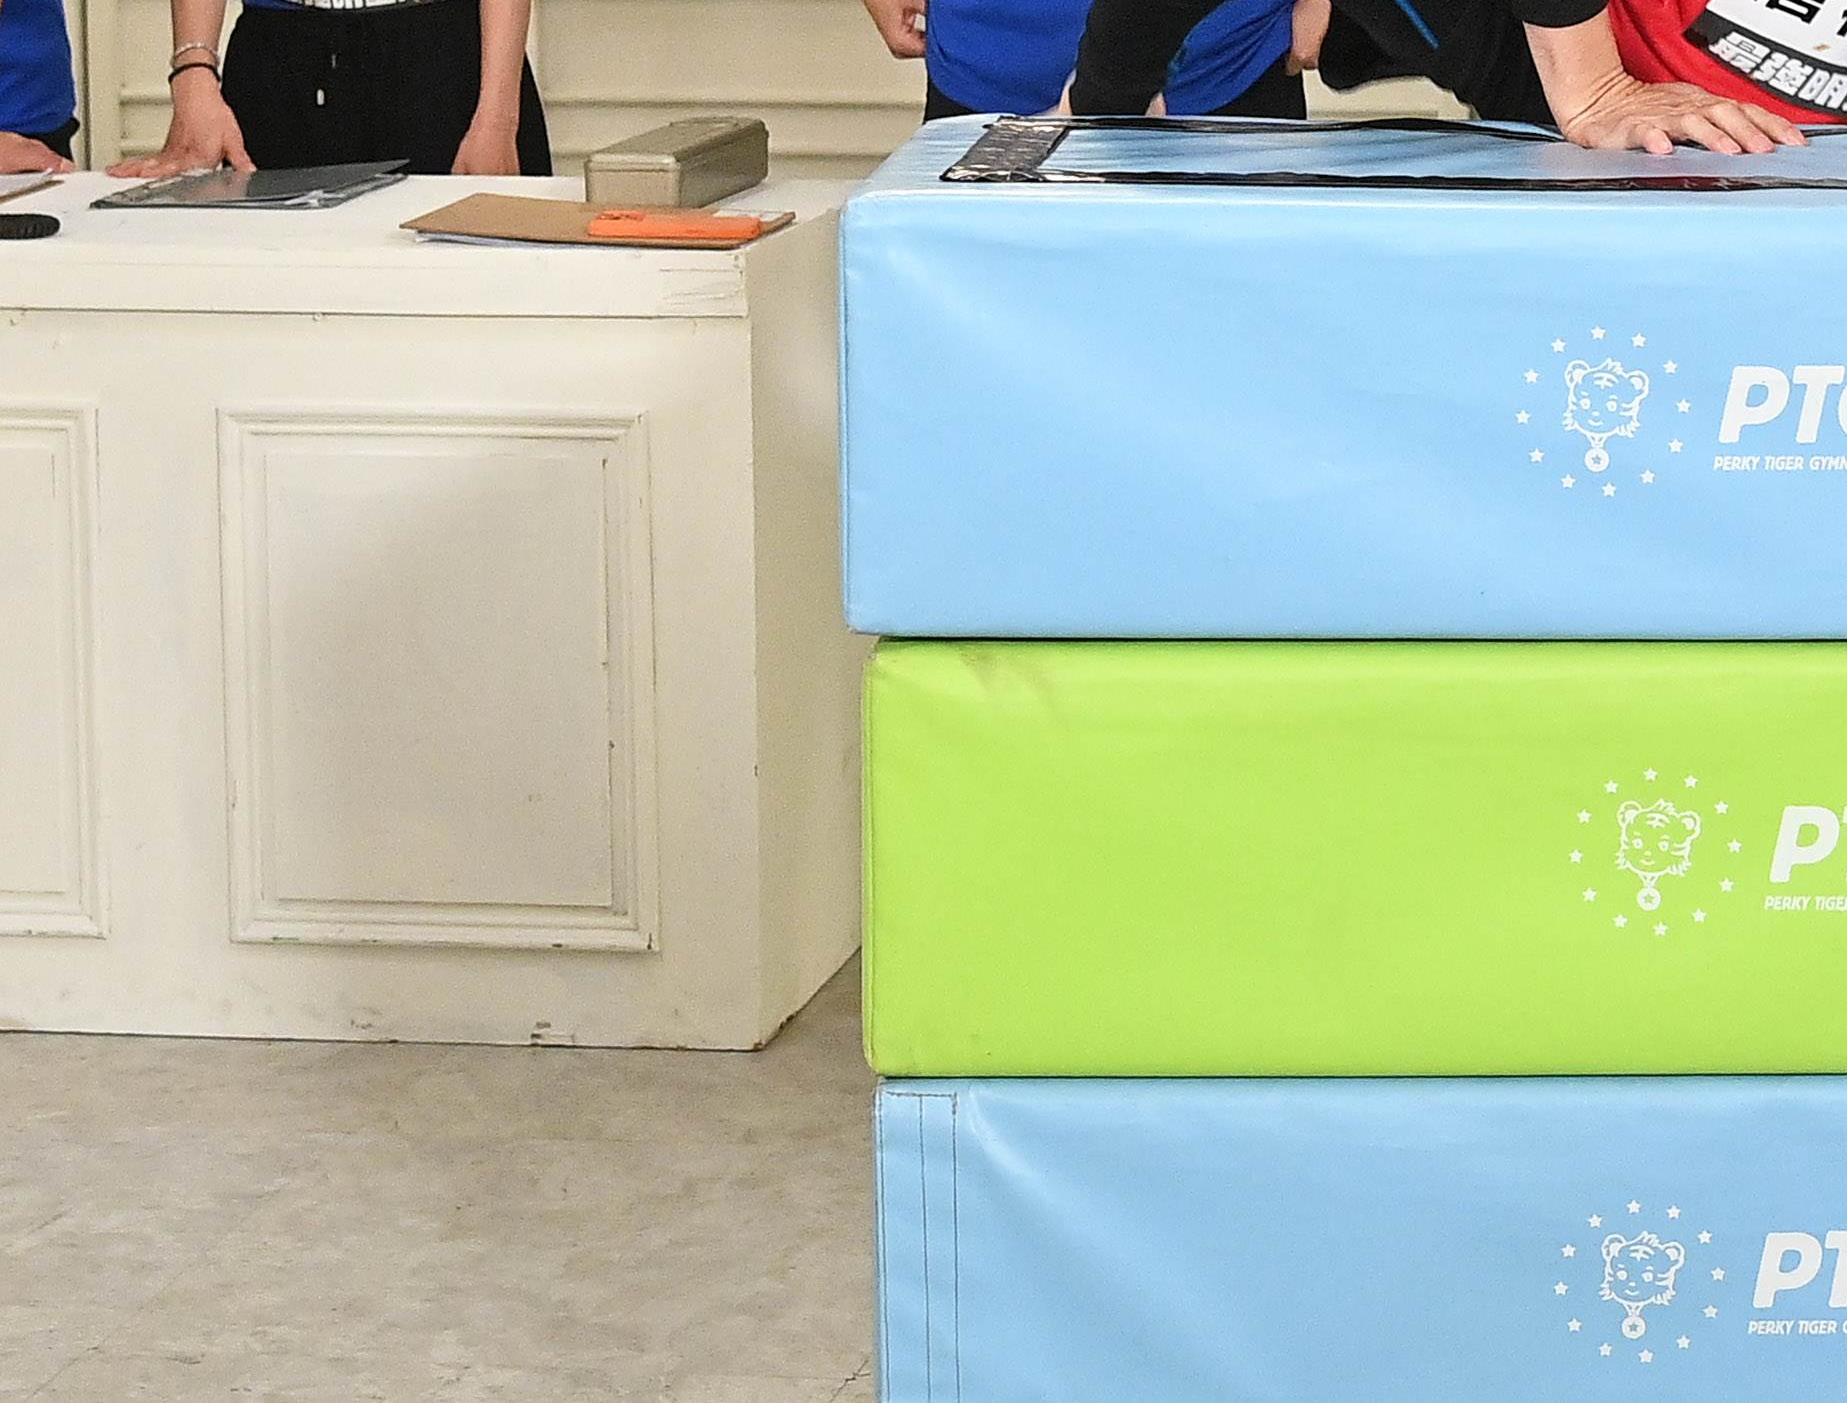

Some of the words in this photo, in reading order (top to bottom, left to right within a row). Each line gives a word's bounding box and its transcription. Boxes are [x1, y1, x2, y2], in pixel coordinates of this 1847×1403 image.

[1713, 456, 1760, 472] PERKY
[1764, 456, 1804, 472] TIGER
[1764, 896, 1811, 913] PERKY
[1748, 1318, 1793, 1336] PERKY
[1797, 1318, 1837, 1336] TIGER
